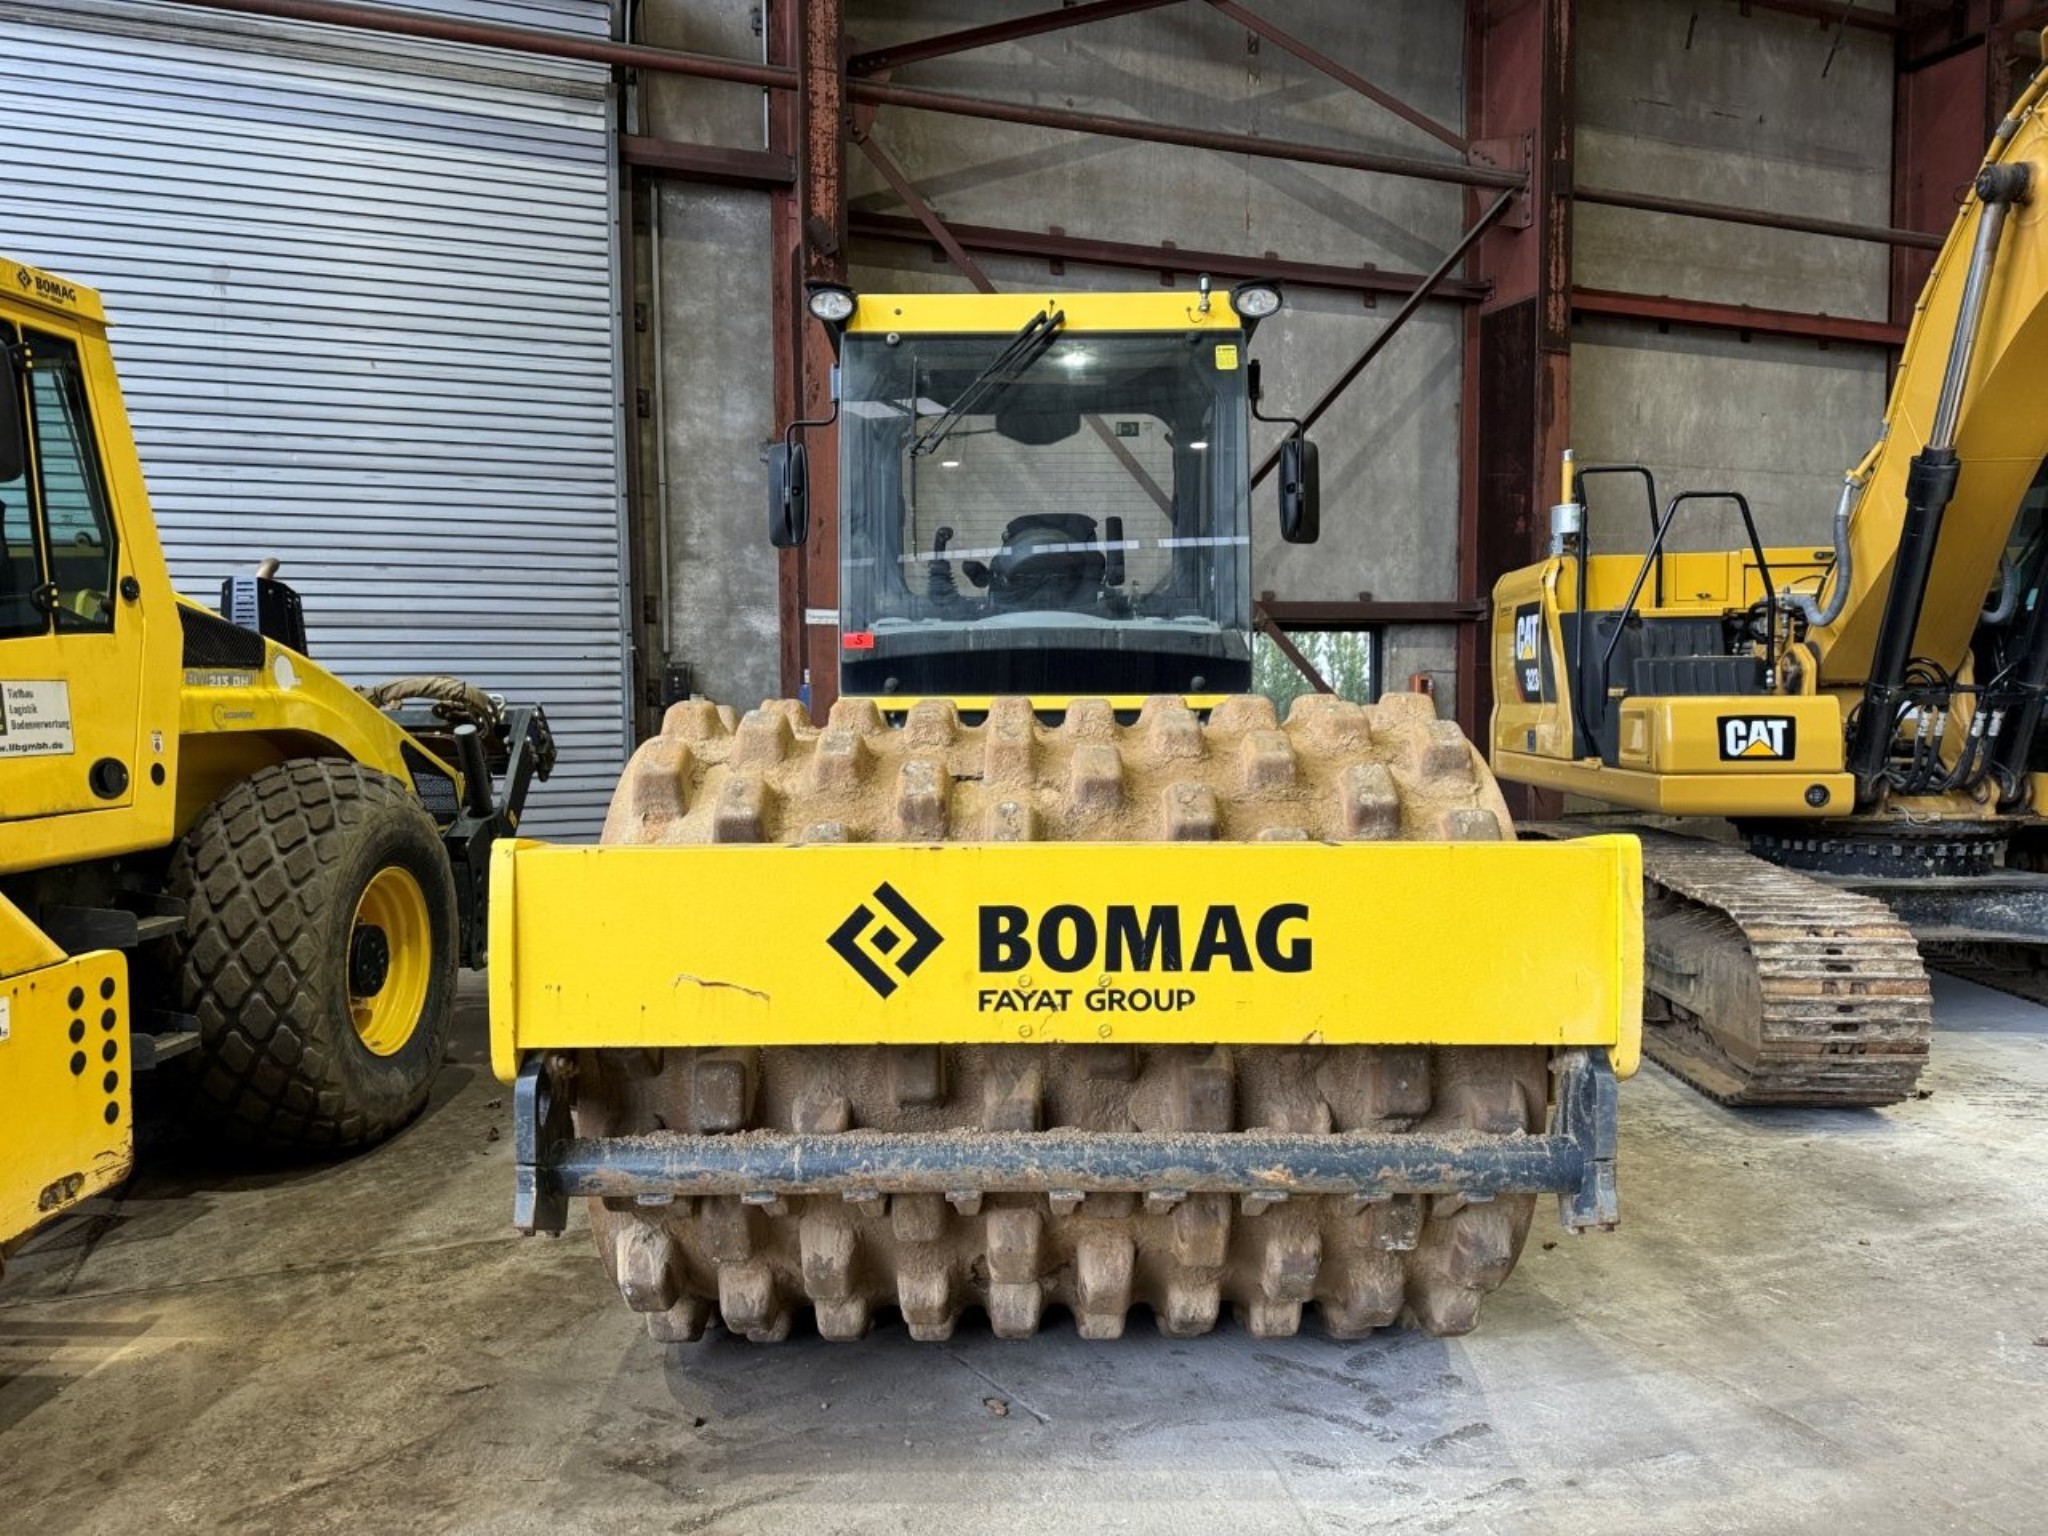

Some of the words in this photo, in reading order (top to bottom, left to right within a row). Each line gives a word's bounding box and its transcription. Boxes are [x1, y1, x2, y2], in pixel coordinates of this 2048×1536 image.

[35, 276, 76, 301] BOMAG
[1516, 614, 1539, 660] CAT
[1726, 719, 1788, 757] CAT
[979, 904, 1313, 973] BOMAG
[979, 989, 1073, 1012] FAYAT
[1085, 988, 1196, 1012] GROUP
